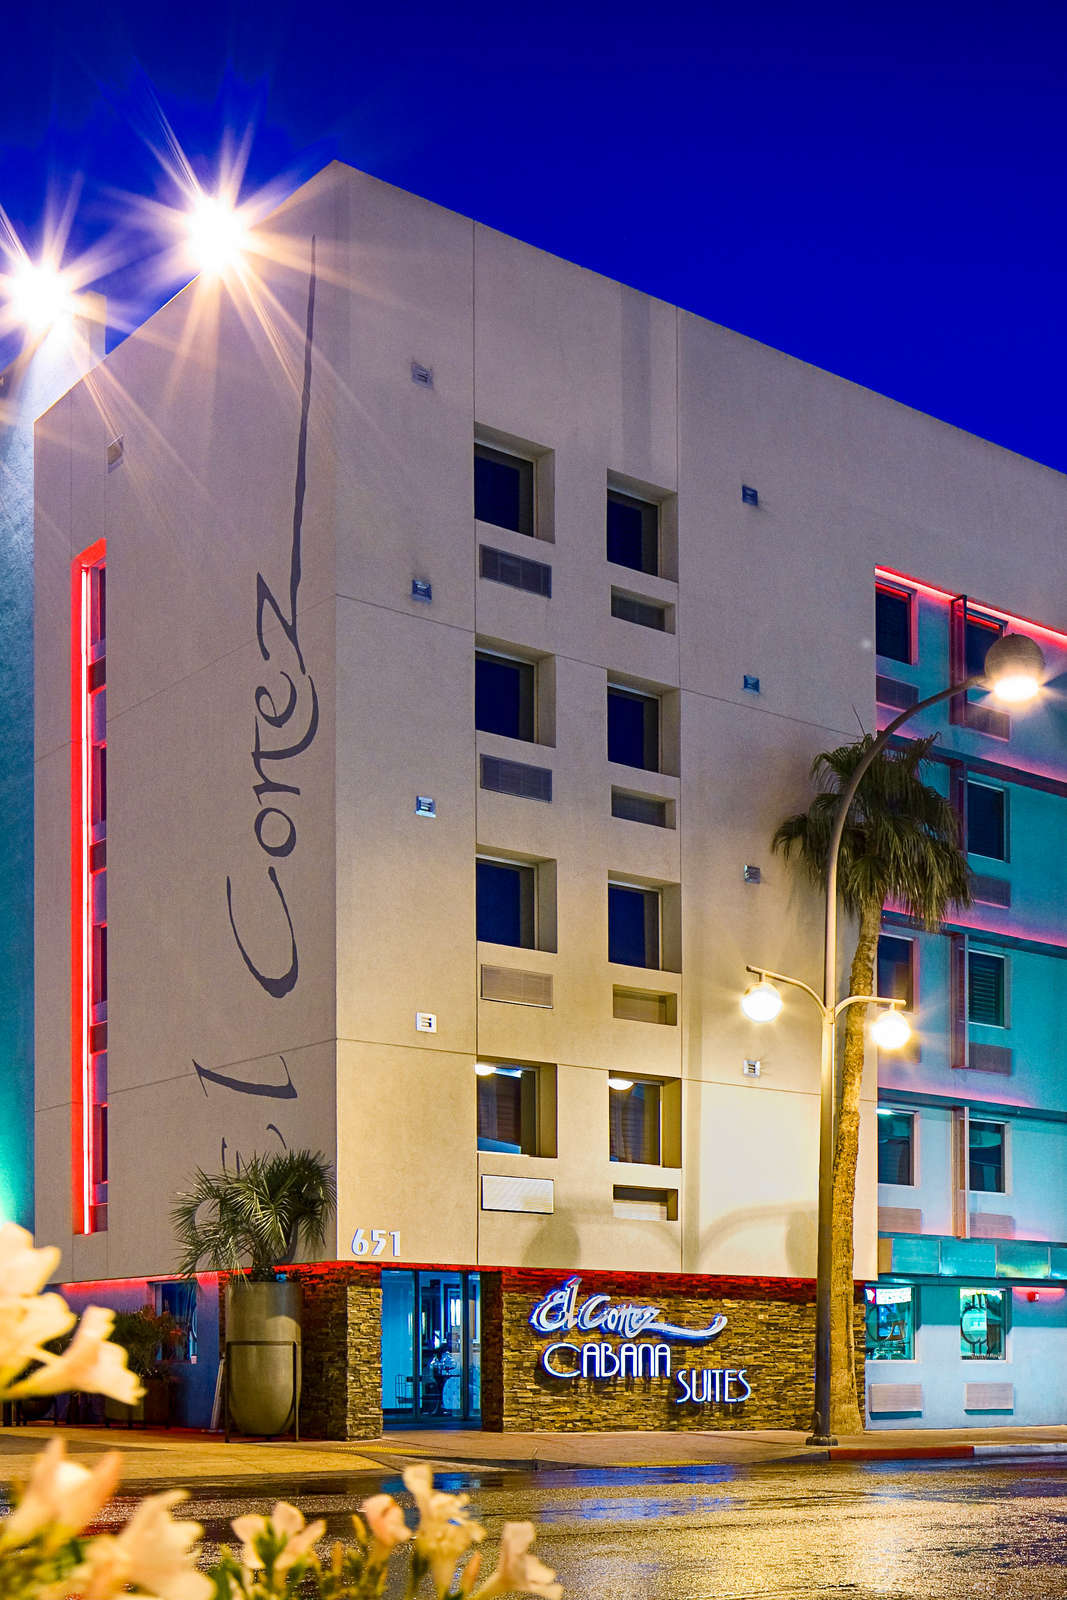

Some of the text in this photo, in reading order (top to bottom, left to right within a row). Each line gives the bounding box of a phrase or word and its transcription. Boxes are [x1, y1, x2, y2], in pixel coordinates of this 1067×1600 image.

[351, 1228, 401, 1257] 651
[530, 1275, 728, 1340] El Cortez
[542, 1342, 671, 1378] CABANA
[675, 1369, 752, 1404] SUITES
